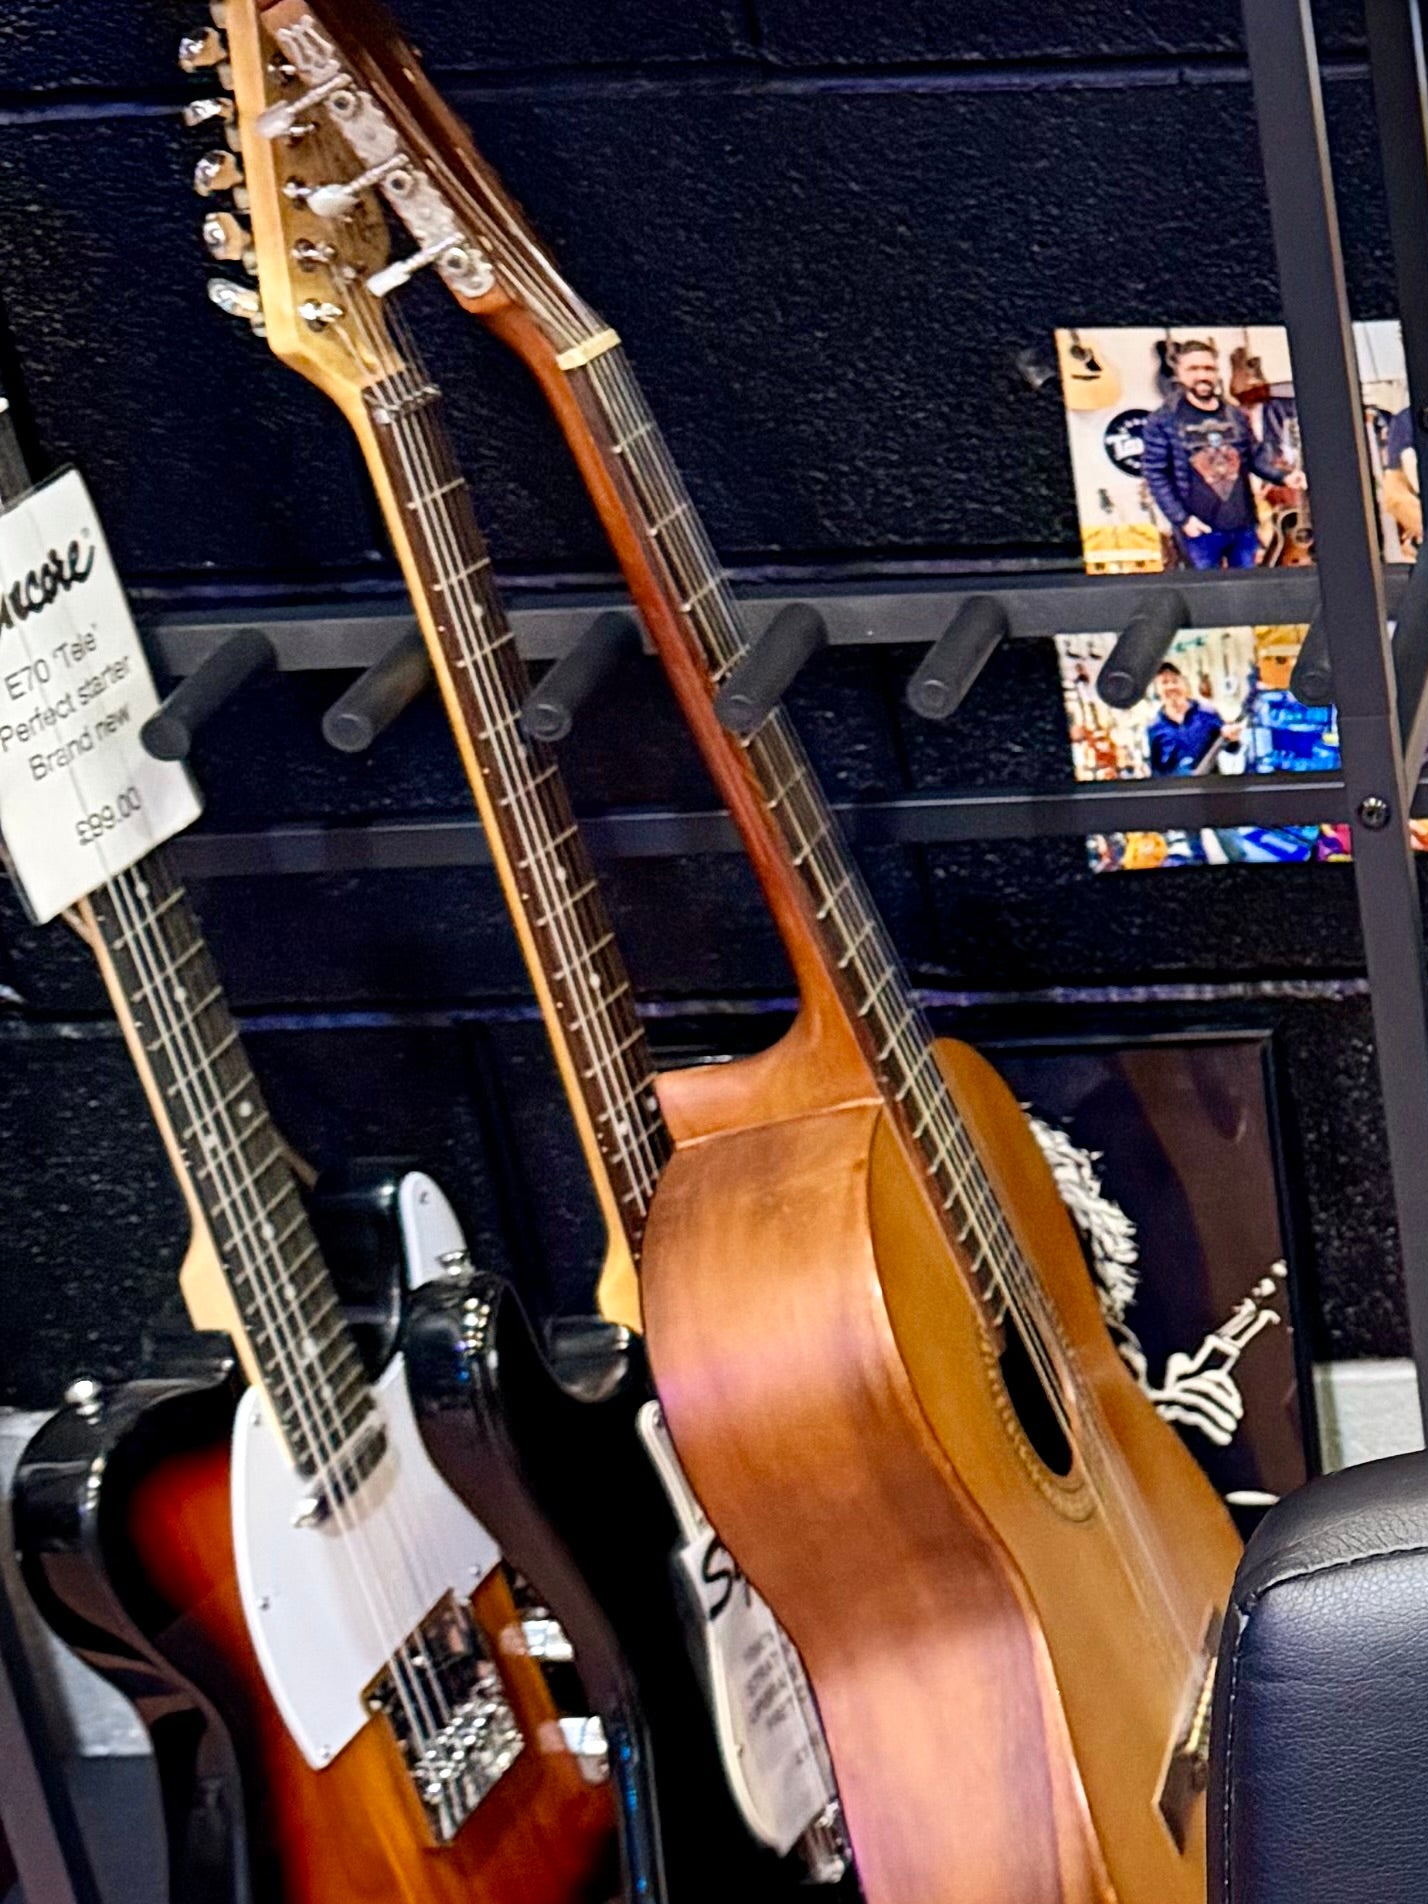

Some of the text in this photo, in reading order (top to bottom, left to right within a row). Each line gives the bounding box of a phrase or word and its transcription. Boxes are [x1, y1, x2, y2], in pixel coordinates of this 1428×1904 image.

[0, 540, 96, 630] ncore
[0, 655, 131, 753] Perfect starter
[3, 657, 51, 701] E70
[28, 702, 132, 782] Brand new
[74, 786, 142, 846] £99.00
